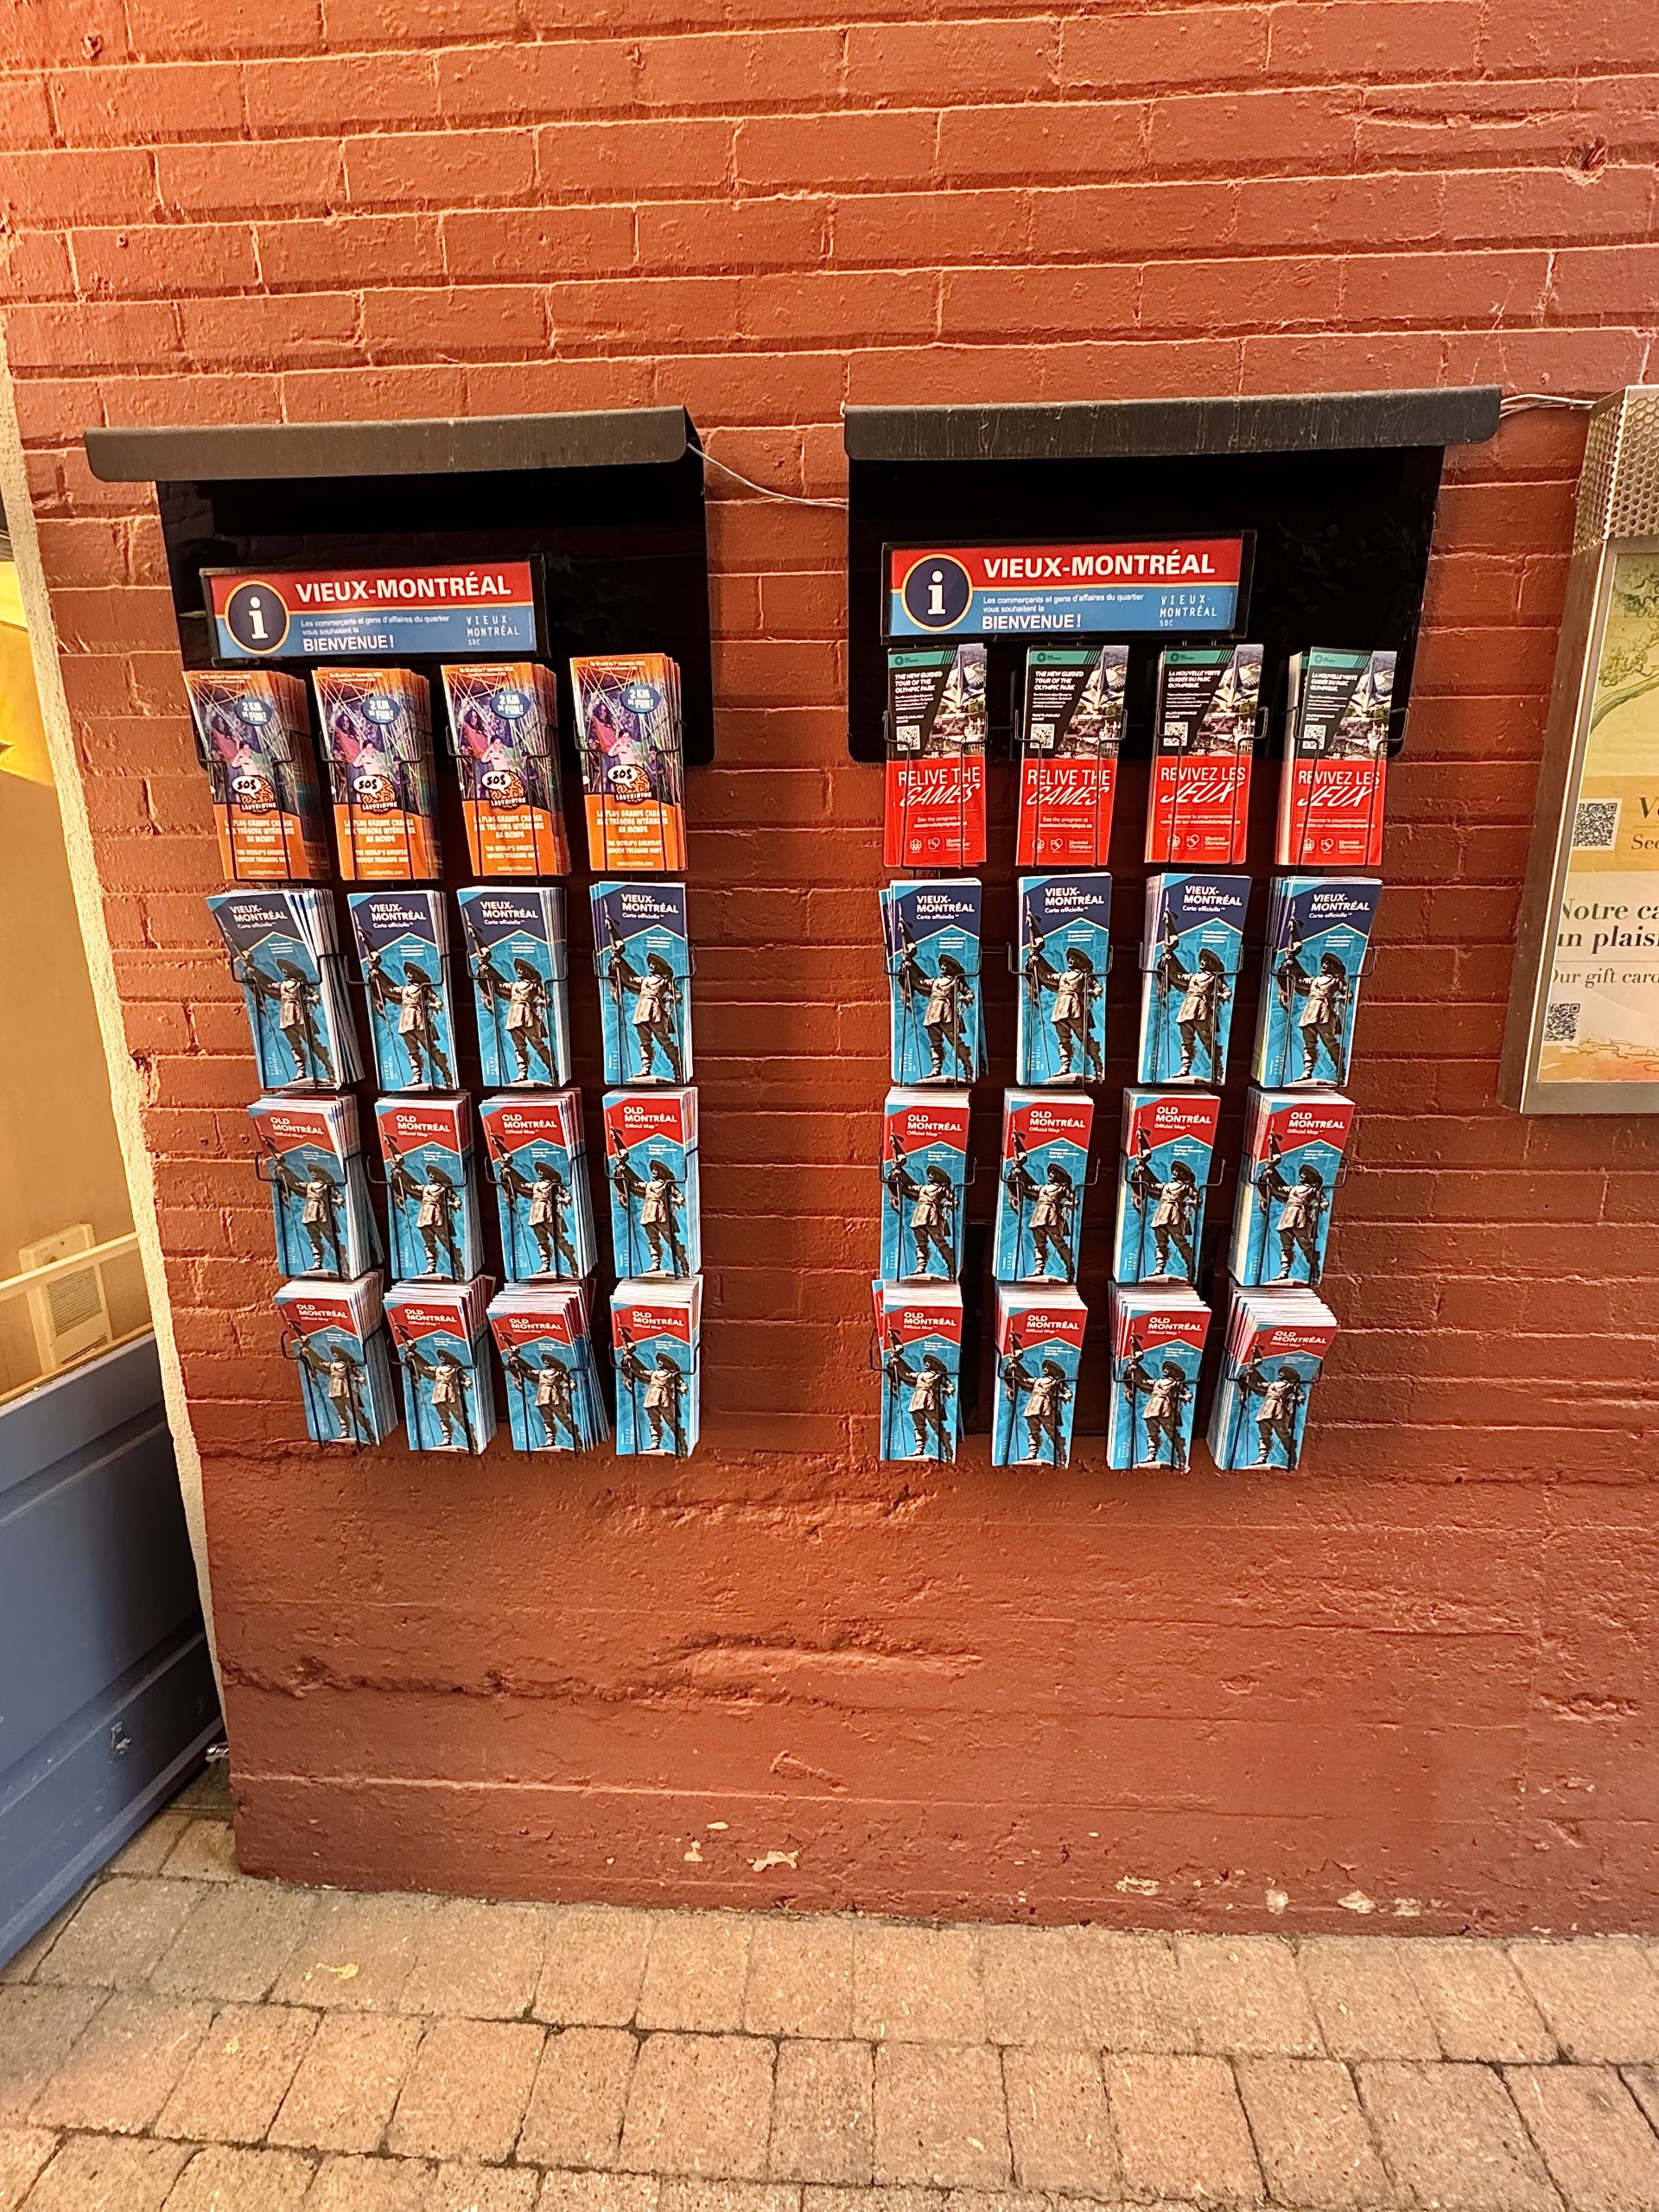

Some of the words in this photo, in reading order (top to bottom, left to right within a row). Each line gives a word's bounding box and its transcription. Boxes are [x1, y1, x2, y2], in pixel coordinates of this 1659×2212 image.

[983, 550, 1215, 579] VIEUX-MONTRÉAL
[296, 571, 512, 603] VIEUX-MONTRÉAL
[997, 596, 1043, 606] commerçants
[1054, 596, 1071, 605] gens
[1072, 594, 1104, 602] d'affaires
[1117, 594, 1144, 602] quartier
[1160, 605, 1217, 618] MONTRÉAL
[315, 618, 356, 626] commerçants
[424, 614, 449, 623] quartier
[467, 625, 520, 637] MONTRÉAL
[499, 694, 506, 703] 2
[629, 690, 637, 699] 2
[613, 768, 632, 779] SOS
[898, 769, 948, 787] RELIVE
[951, 766, 981, 784] THE
[1027, 769, 1078, 785] RELIVE
[1082, 770, 1111, 785] THE
[1160, 767, 1218, 781] REVIVEZ
[1221, 767, 1246, 781] LES
[1299, 770, 1353, 785] REVIVEZ
[1356, 771, 1380, 785] LES
[359, 779, 378, 790] SOS
[486, 774, 507, 785] SOS
[238, 779, 257, 791] SOS
[899, 783, 981, 807] GAMES
[1026, 786, 1110, 805] GAMES
[1160, 782, 1245, 804] JEUX
[1297, 785, 1378, 807] JEUX
[1640, 797, 1659, 818] V
[1045, 887, 1080, 896] VIEUX-
[1185, 886, 1220, 895] VIEUX-
[621, 893, 656, 903] VIEUX-
[916, 895, 951, 904] VIEUX-
[1045, 894, 1104, 906] MONTRÉAL
[1183, 893, 1243, 906] MONTRÉAL
[1313, 893, 1348, 902] VIEUX-
[230, 904, 263, 914] VIEUX-
[369, 904, 403, 913] VIEUX-
[480, 901, 514, 910] VIEUX-
[622, 903, 679, 913] MONTRÉAL
[916, 902, 975, 912] MONTRÉAL
[1311, 900, 1370, 911] MONTRÉAL
[232, 911, 288, 922] MONTRÉAL
[372, 911, 427, 921] MONTRÉAL
[483, 908, 539, 918] MONTRÉAL
[1585, 967, 1617, 988] gift
[624, 1106, 644, 1115] OLD
[1030, 1110, 1052, 1119] OLD
[1156, 1106, 1178, 1115] OLD
[1290, 1111, 1312, 1120] OLD
[270, 1116, 290, 1125] OLD
[396, 1114, 416, 1123] OLD
[502, 1113, 523, 1122] OLD
[625, 1113, 677, 1123] MONTRÉAL
[907, 1114, 928, 1122] OLD
[1029, 1117, 1085, 1128] MONTRÉAL
[1155, 1114, 1211, 1124] MONTRÉAL
[397, 1122, 450, 1132] MONTRÉAL
[504, 1119, 557, 1129] MONTRÉAL
[907, 1122, 963, 1132] MONTRÉAL
[1288, 1118, 1344, 1129] MONTRÉAL
[272, 1123, 325, 1135] MONTRÉAL
[298, 1309, 349, 1319] MONTRÉAL
[406, 1313, 457, 1323] MONTRÉAL
[632, 1317, 684, 1327] MONTRÉAL
[903, 1318, 957, 1327] MONTRÉAL
[1026, 1320, 1080, 1331] MONTRÉAL
[511, 1323, 563, 1332] MONTRÉAL
[1147, 1323, 1202, 1332] MONTRÉAL
[1272, 1336, 1327, 1344] MONTRÉAL
